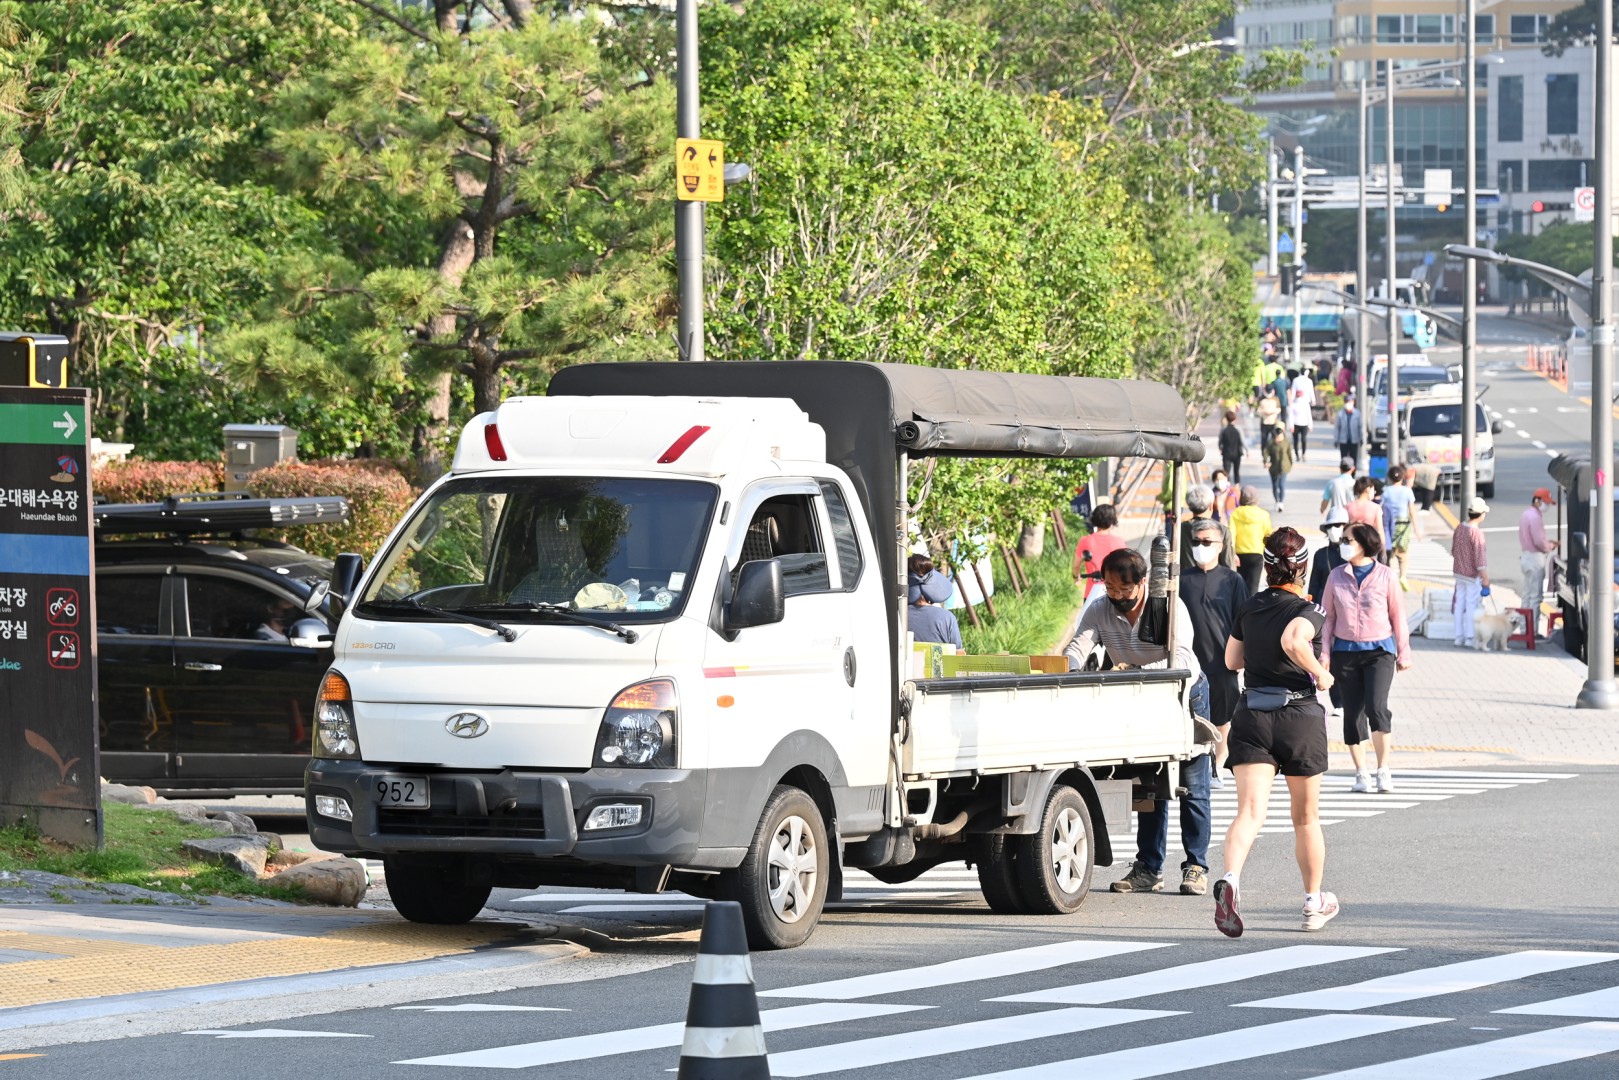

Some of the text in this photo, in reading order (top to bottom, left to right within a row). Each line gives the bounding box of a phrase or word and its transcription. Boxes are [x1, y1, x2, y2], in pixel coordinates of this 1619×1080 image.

[20, 512, 77, 521] Haeundae Beach
[377, 781, 415, 802] 952
